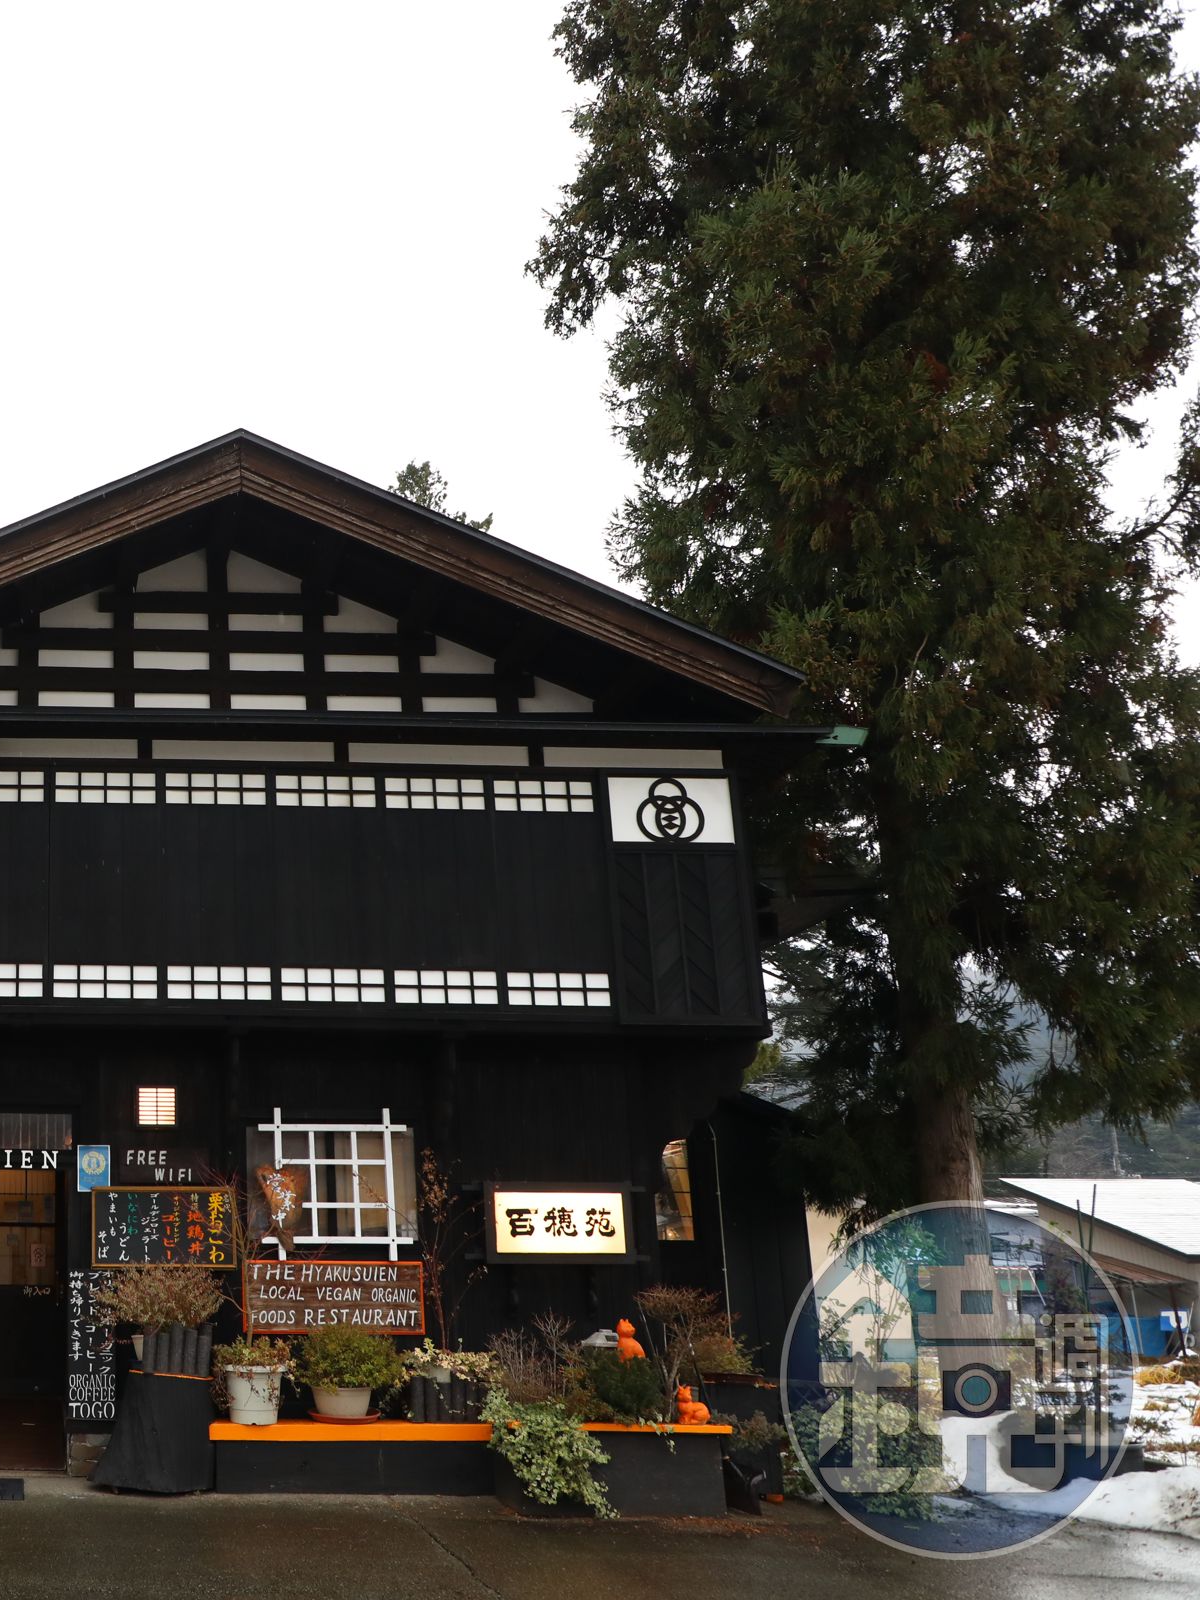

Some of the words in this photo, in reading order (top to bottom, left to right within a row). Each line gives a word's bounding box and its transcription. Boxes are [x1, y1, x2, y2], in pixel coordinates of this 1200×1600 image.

[127, 1150, 167, 1165] FREE
[155, 1168, 192, 1182] WIFI
[108, 1192, 118, 1237] やまいも
[127, 1193, 138, 1235] いなにわ
[506, 1207, 616, 1237] 百穂苑
[98, 1231, 109, 1259] そば
[119, 1222, 130, 1261] うどん
[140, 1216, 151, 1263] ジェラート
[161, 1214, 176, 1260] コーヒー
[250, 1264, 296, 1281] THE
[301, 1264, 398, 1283] HYAKUSUIEN
[260, 1285, 305, 1301] LOCAL
[316, 1287, 361, 1301] VEGAN
[371, 1288, 416, 1303] ORGANIC
[251, 1309, 297, 1325] FOODS
[304, 1308, 418, 1327] RESTAURANT
[69, 1374, 116, 1389] ORGANIC
[69, 1387, 116, 1402] COFFEE
